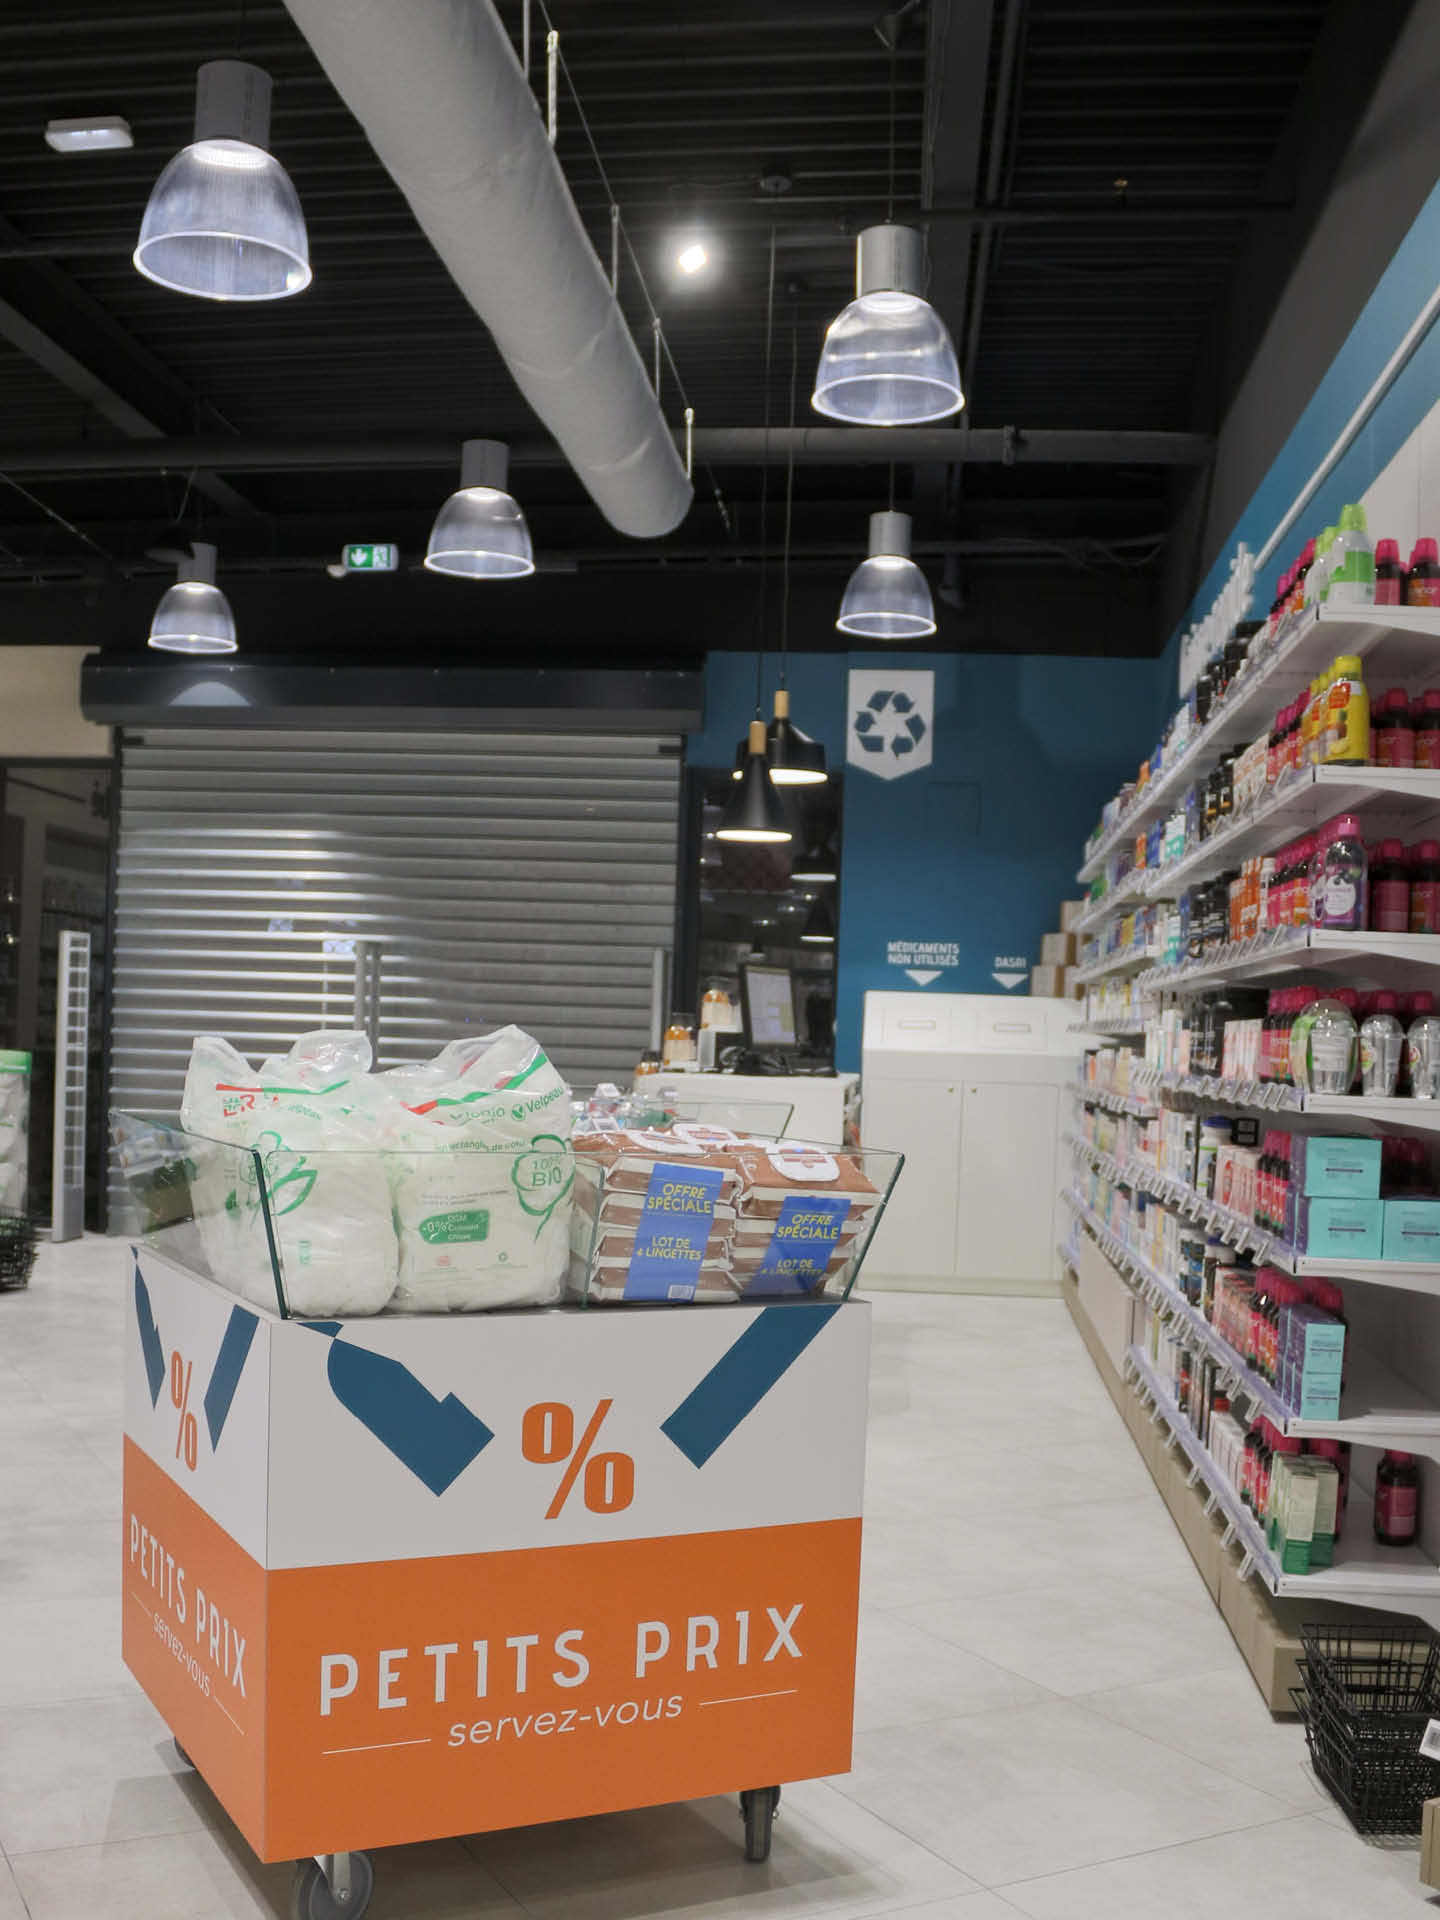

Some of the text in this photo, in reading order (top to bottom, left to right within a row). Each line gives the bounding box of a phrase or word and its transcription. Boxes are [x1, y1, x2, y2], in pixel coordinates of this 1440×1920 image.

[887, 953, 911, 964] NON
[525, 1087, 564, 1113] Velpeau
[532, 1166, 562, 1186] BIO
[662, 1183, 707, 1200] OFFRE
[647, 1195, 712, 1214] SPÉCIALE
[791, 1214, 834, 1226] OFFRE
[776, 1224, 840, 1240] SPÉCIALE
[651, 1236, 691, 1249] LOT DE
[645, 1249, 702, 1261] LINGETTES
[777, 1259, 815, 1269] LOT DE
[521, 1398, 635, 1520] %
[130, 1513, 247, 1698] PETITS PRIX
[153, 1611, 211, 1697] servez-vous
[319, 1603, 805, 1717] PETITS PRIX
[447, 1694, 684, 1748] servez-vous
